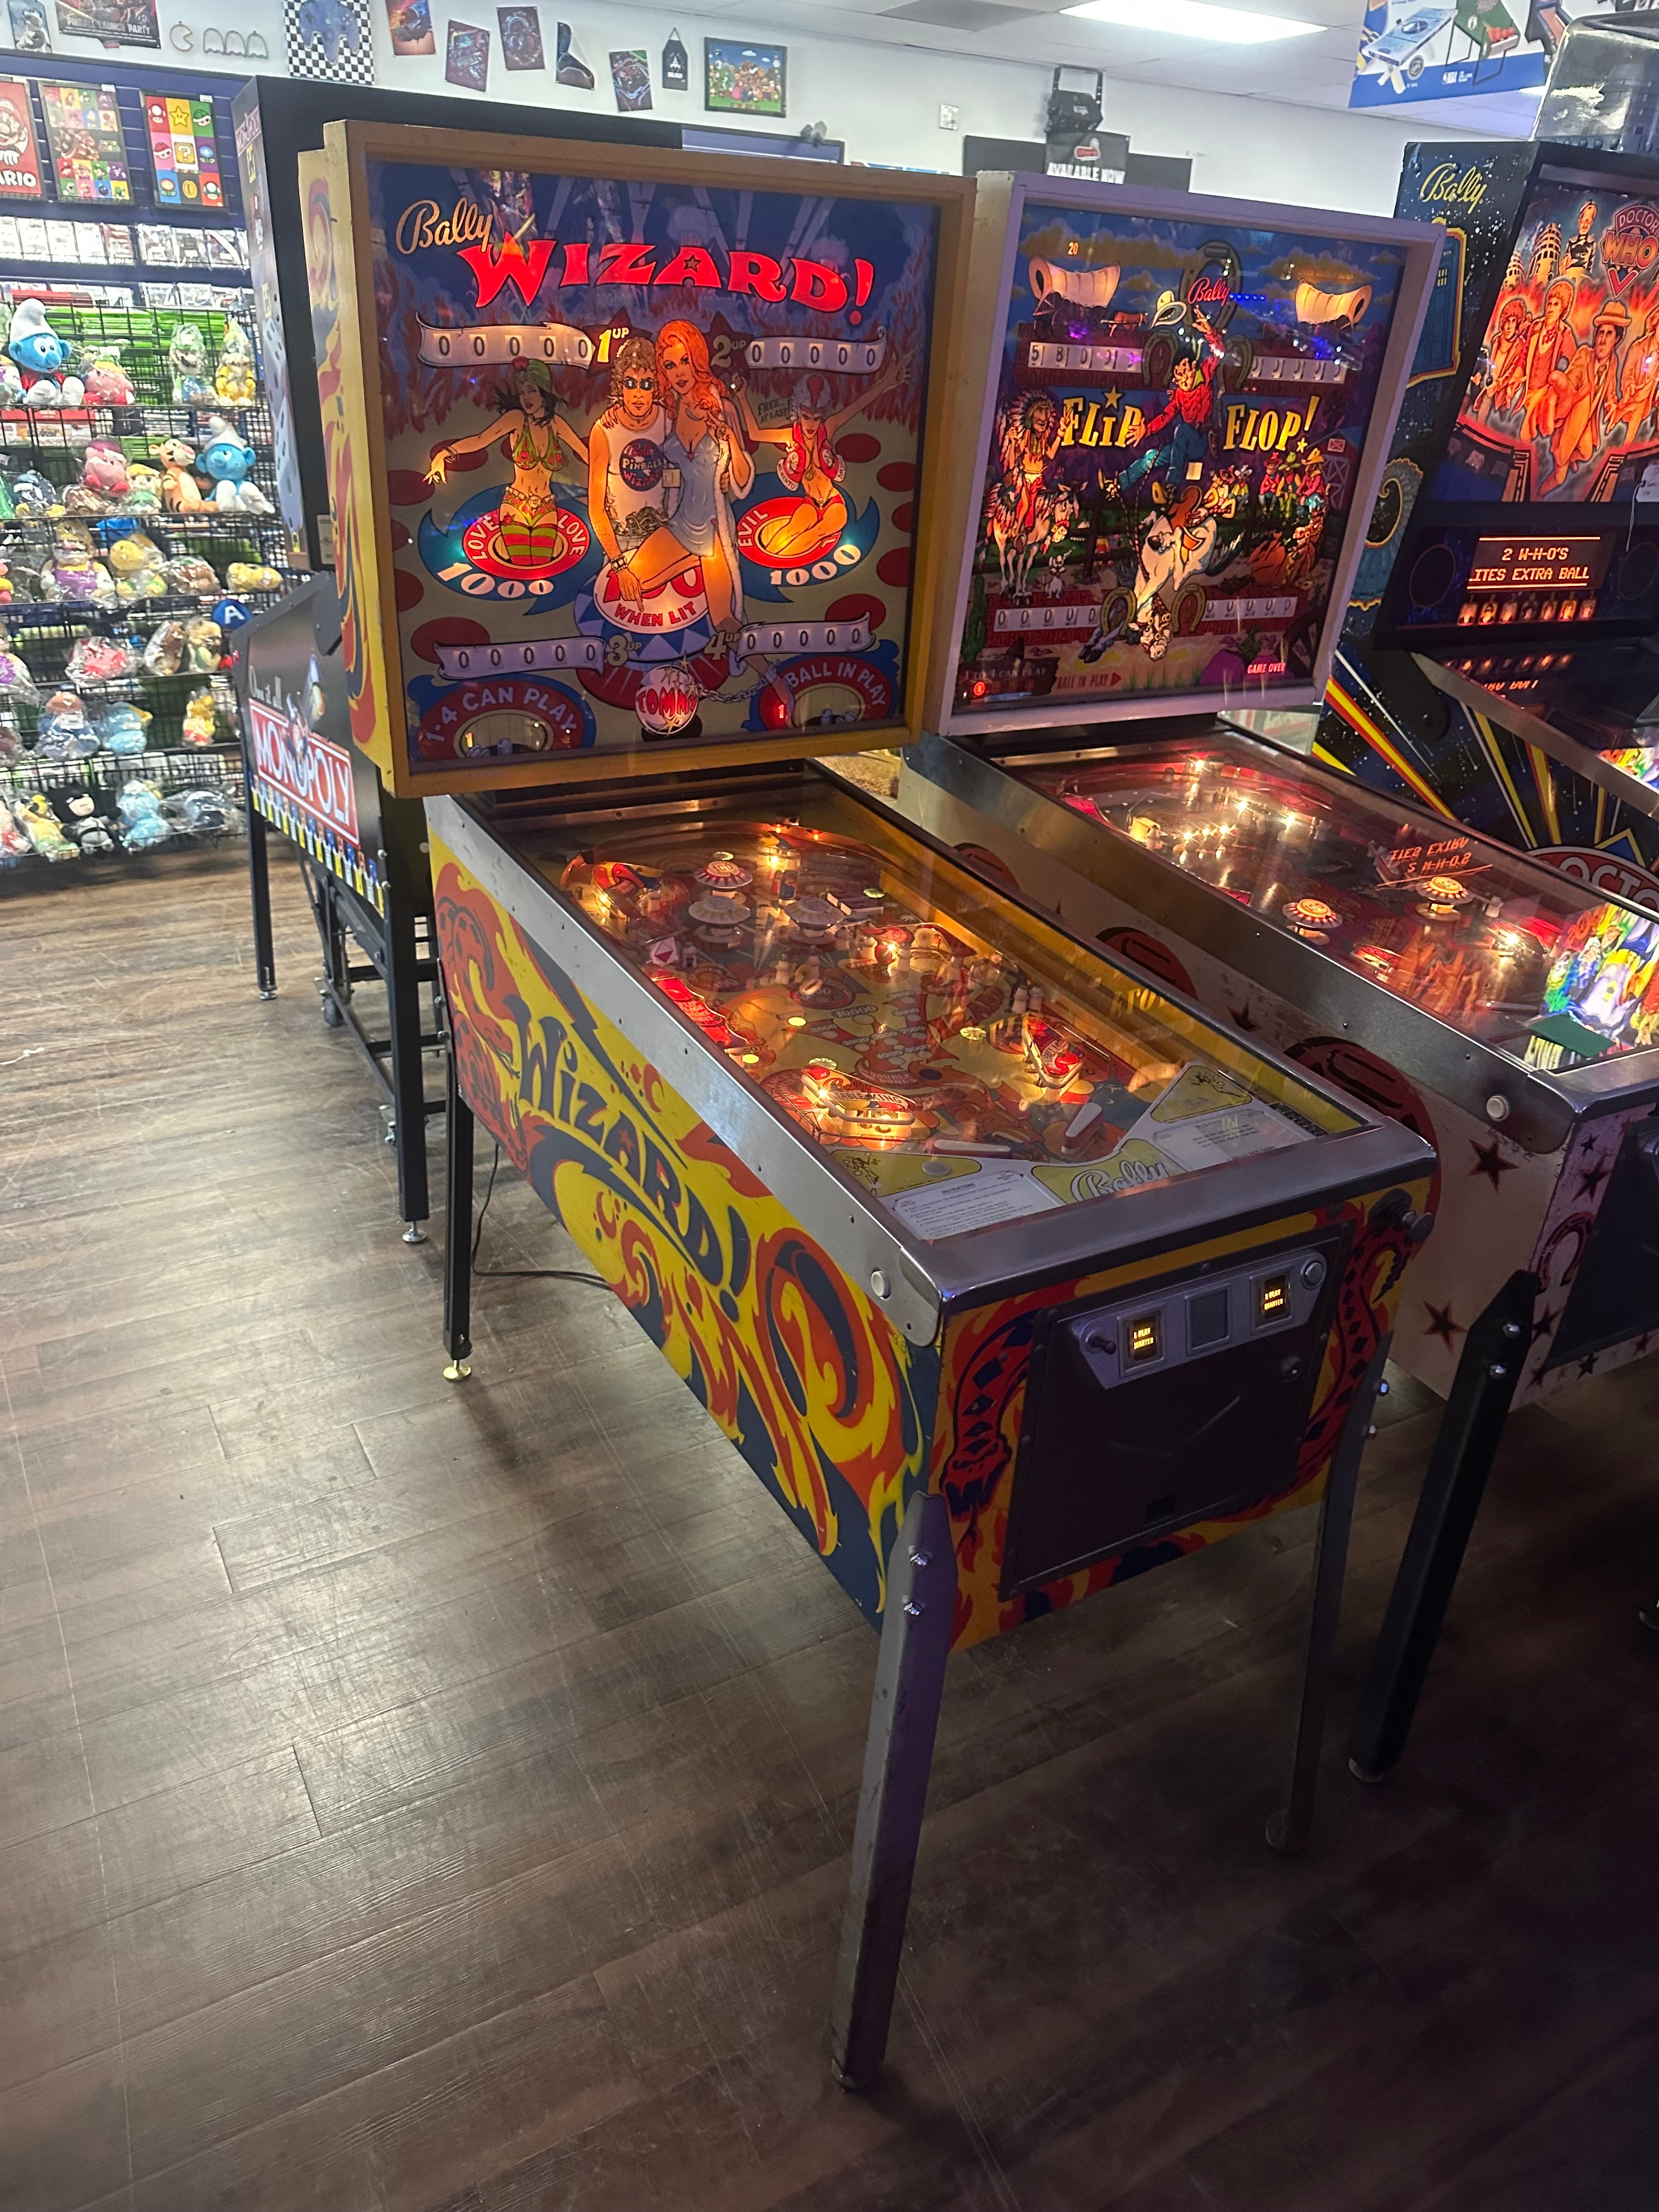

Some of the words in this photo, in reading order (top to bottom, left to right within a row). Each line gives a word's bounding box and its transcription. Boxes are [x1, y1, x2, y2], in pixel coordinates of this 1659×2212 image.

[128, 24, 150, 35] PARTY
[1046, 162, 1100, 182] AVAILABLE
[1101, 168, 1126, 185] NOW
[1420, 163, 1487, 215] Bally
[395, 196, 493, 255] Bally
[1619, 210, 1659, 233] DOCTOR
[1068, 242, 1079, 256] 20
[1602, 230, 1658, 269] WHO
[456, 231, 874, 326] WIZARD!
[1187, 276, 1231, 307] Bally
[1223, 395, 1320, 454] FLOP!
[467, 515, 500, 561] LOVE
[557, 513, 586, 557] LOVE
[737, 509, 769, 548] EVIL
[769, 543, 862, 587] 1000
[1501, 548, 1513, 561] 2
[437, 562, 555, 599] 1000
[1468, 568, 1507, 583] ITES
[1511, 567, 1553, 581] EXTRA
[1558, 566, 1590, 580] BALL
[224, 605, 244, 624] A
[614, 603, 664, 627] WHEN
[668, 601, 697, 624] LIT
[998, 669, 1019, 678] CAN
[1022, 668, 1046, 676] PLAY
[1246, 662, 1267, 675] GAME
[1268, 662, 1286, 673] OVER
[785, 662, 833, 688] BALL
[837, 660, 858, 678] IN
[858, 668, 887, 706] PLAY
[461, 686, 514, 711] CAN
[523, 687, 578, 731] PLAY
[636, 686, 698, 718] TOMMY
[713, 864, 733, 872] 100
[836, 1005, 876, 1018] 10,000
[872, 1094, 902, 1104] KING
[1264, 1298, 1284, 1310] QUARTER
[1269, 1289, 1281, 1299] PLAY
[1138, 1327, 1151, 1338] PLAY
